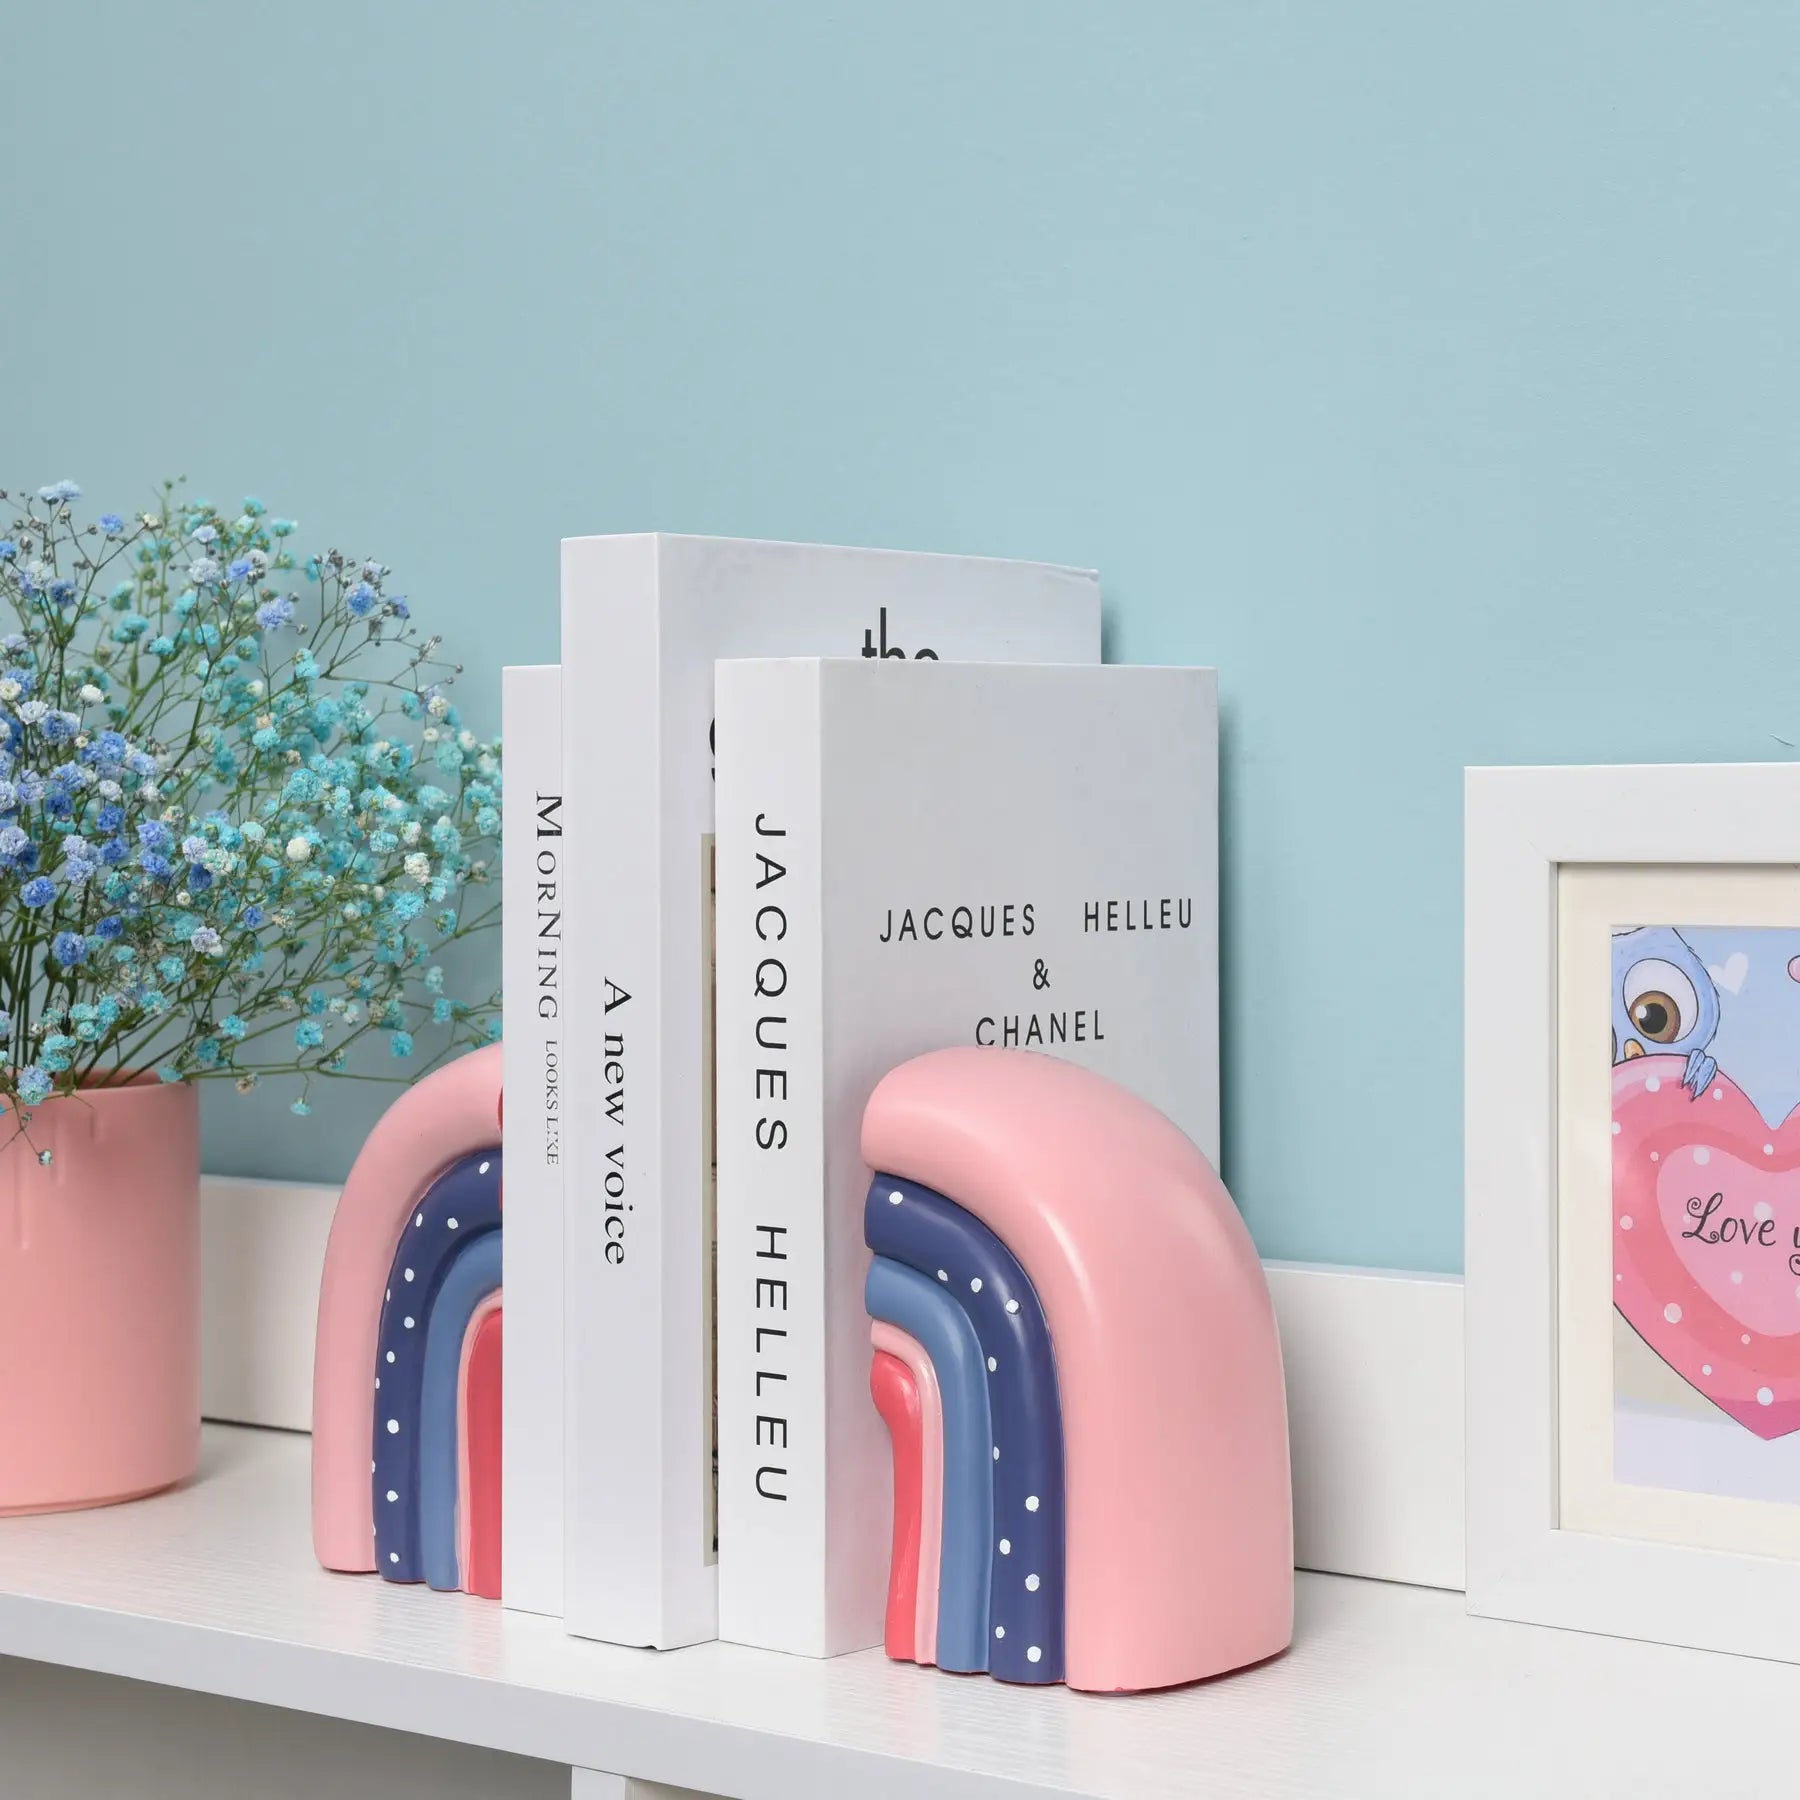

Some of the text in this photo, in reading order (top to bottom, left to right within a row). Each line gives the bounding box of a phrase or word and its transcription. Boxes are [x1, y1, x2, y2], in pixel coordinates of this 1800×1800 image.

[536, 791, 562, 1019] MORNING
[879, 897, 1193, 943] JACQUES HELLEU
[1032, 957, 1051, 991] &
[975, 1009, 1105, 1047] CHANEL
[545, 1039, 559, 1111] LOOKS
[604, 976, 634, 1265] A new voice
[753, 812, 788, 1502] JACQUES HELLEU
[1681, 1192, 1777, 1247] Love
